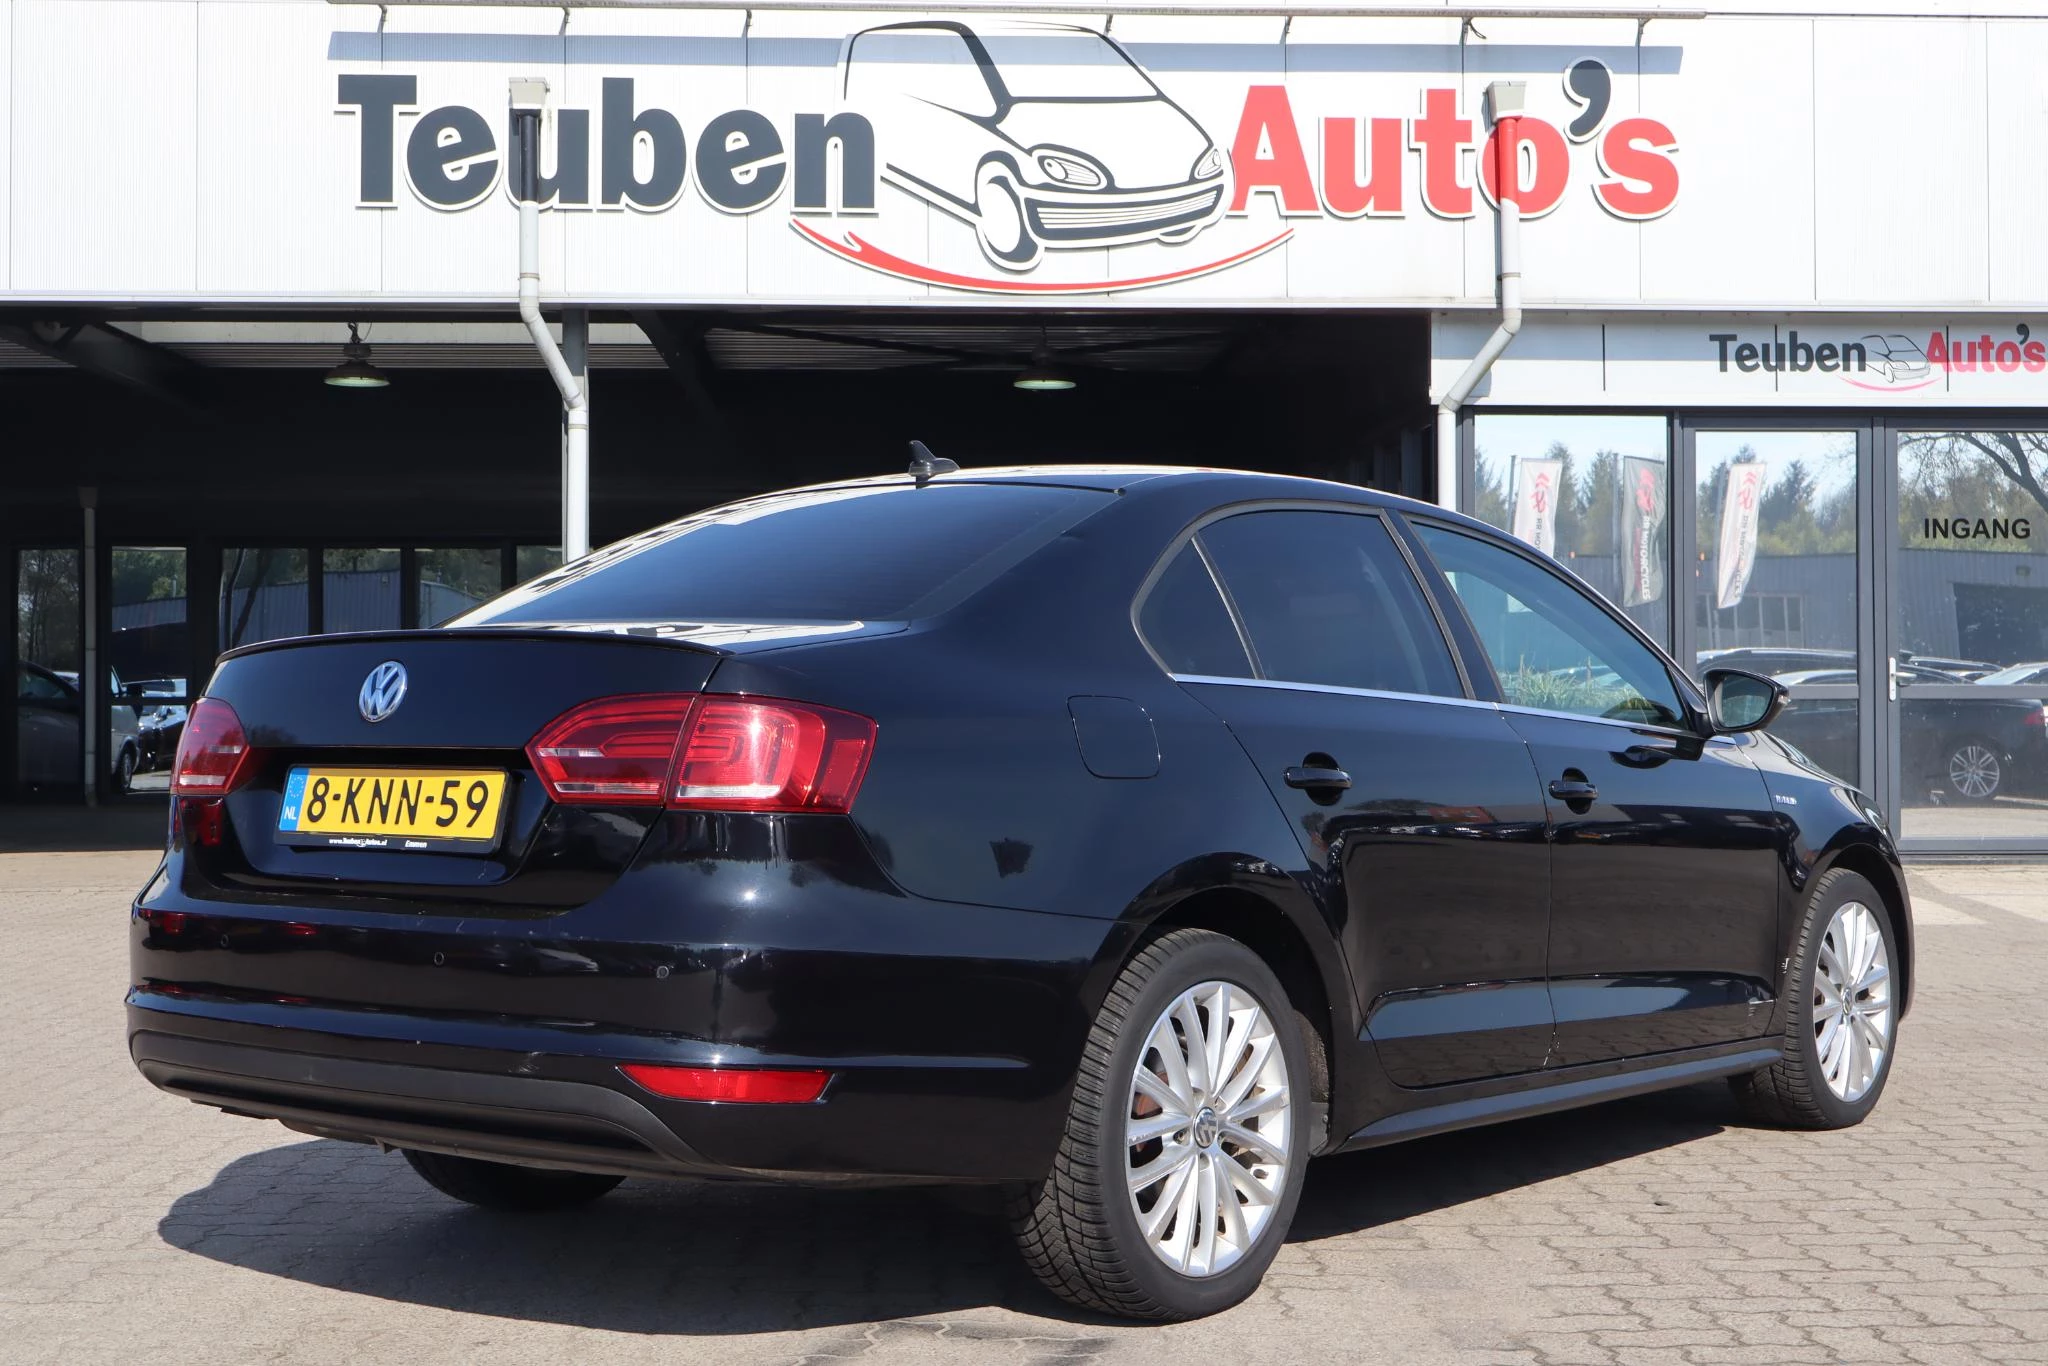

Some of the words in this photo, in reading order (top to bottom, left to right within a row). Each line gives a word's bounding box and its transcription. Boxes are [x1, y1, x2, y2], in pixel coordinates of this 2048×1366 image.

[338, 74, 875, 210] Teuben
[1229, 59, 1679, 214] Auto's
[1709, 330, 1866, 373] Teuben
[1926, 323, 2046, 373] Auto's
[1924, 518, 2031, 539] INGANG
[1640, 530, 1651, 600] MOTORCYCLES
[283, 805, 297, 821] NL
[306, 777, 489, 828] 8-KNN-59
[405, 839, 427, 848] Emmen
